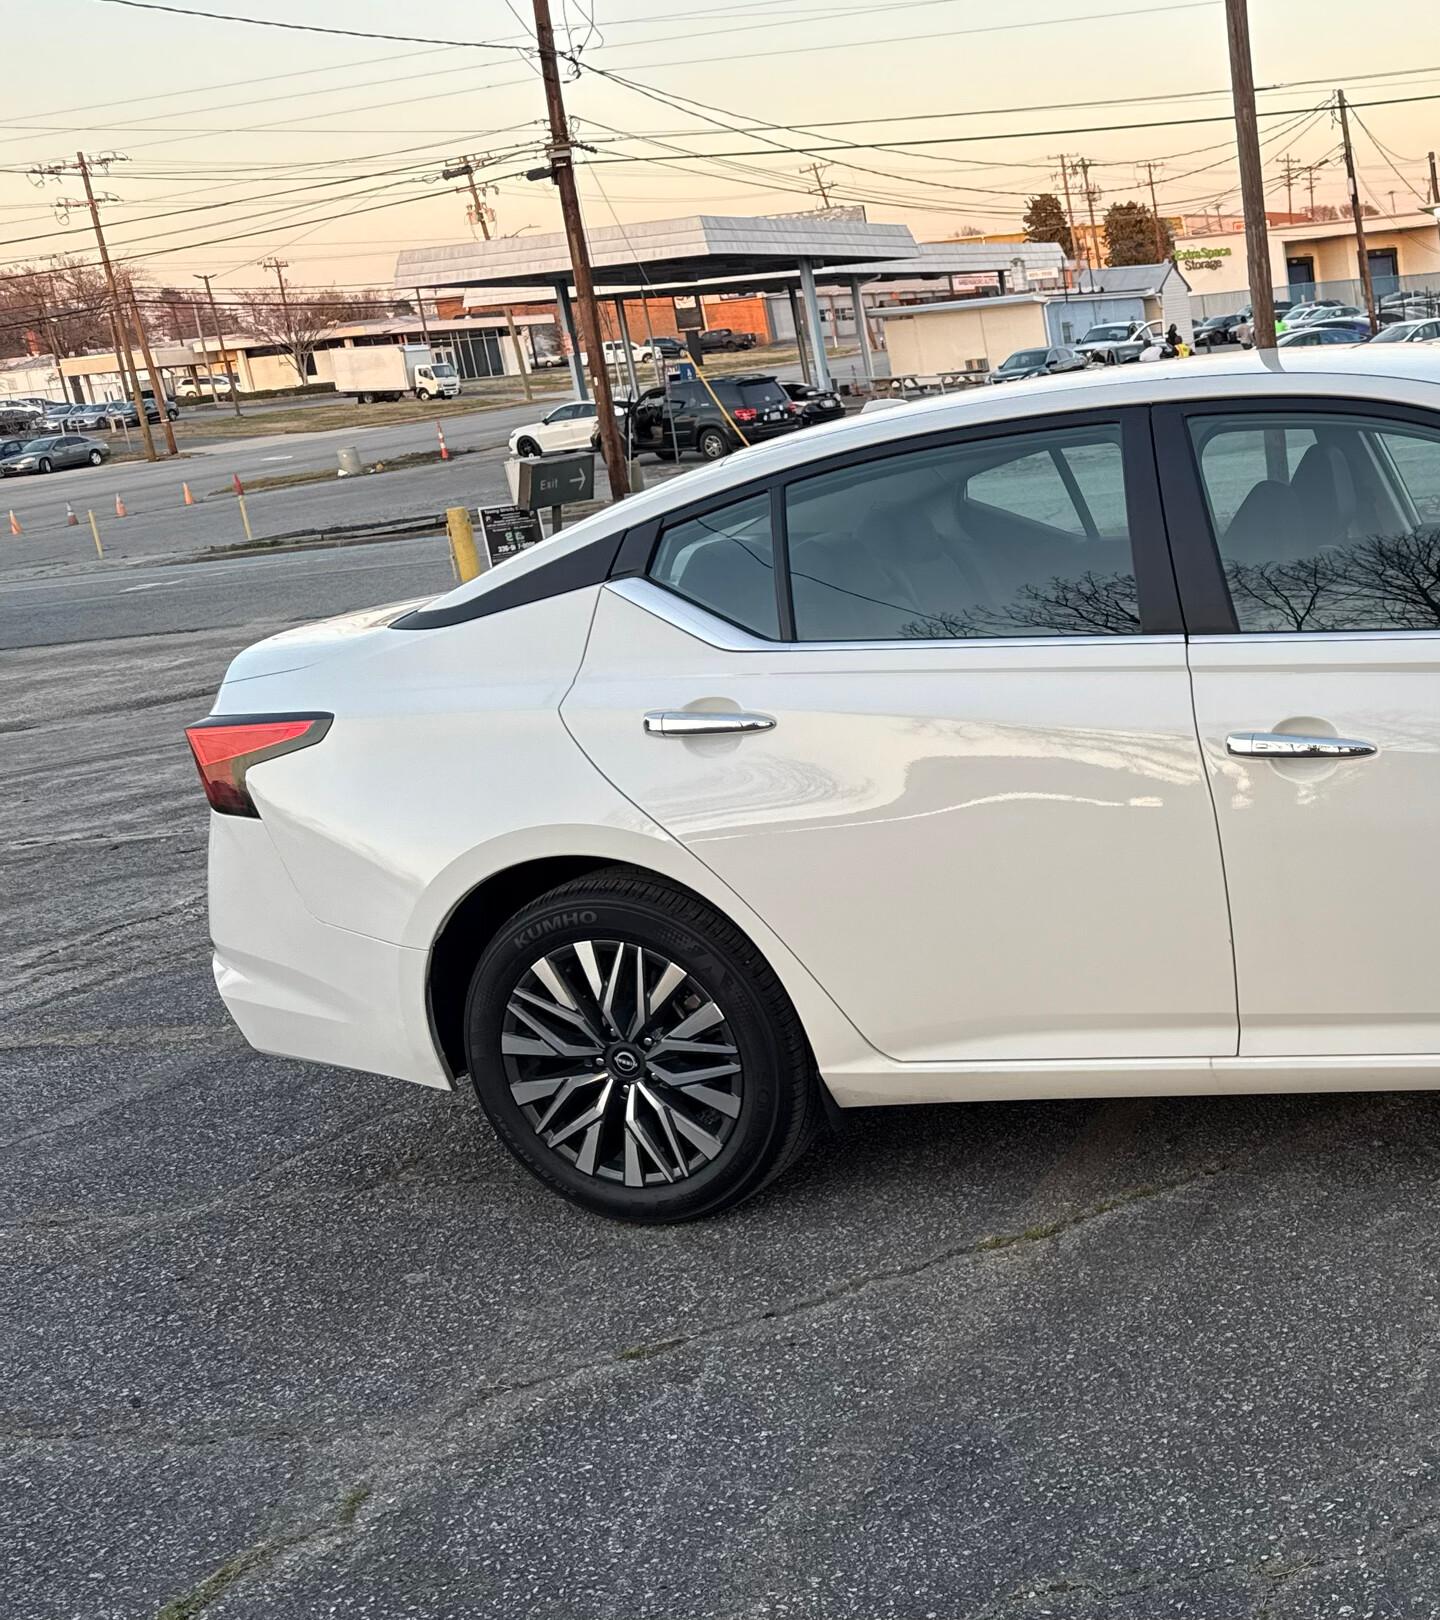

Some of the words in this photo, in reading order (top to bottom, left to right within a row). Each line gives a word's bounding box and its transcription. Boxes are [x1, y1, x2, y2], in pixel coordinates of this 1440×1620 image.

[1184, 259, 1223, 271] Storage
[540, 479, 558, 491] Exit
[514, 911, 597, 949] KUMHO
